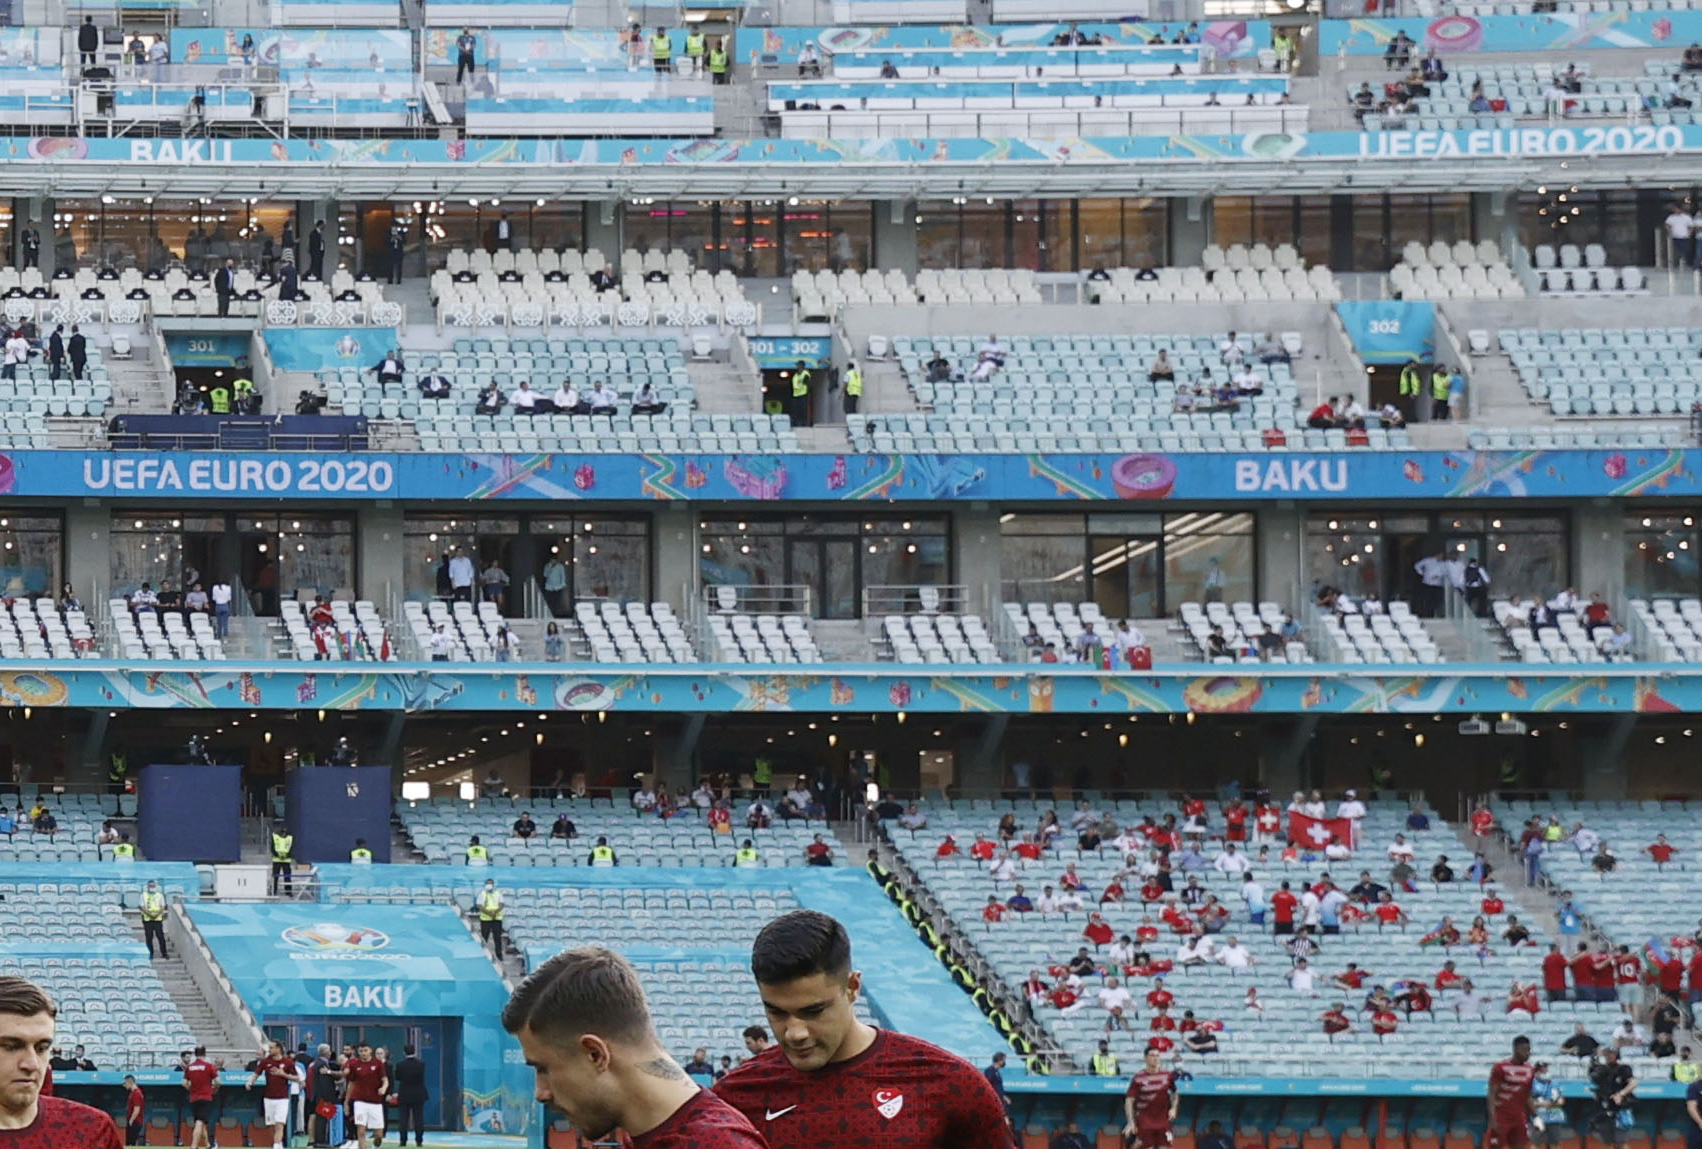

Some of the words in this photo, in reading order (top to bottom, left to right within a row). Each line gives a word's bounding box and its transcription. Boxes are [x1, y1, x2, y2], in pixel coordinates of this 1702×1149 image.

[130, 139, 233, 162] BAKU
[1359, 131, 1460, 157] UEFA
[1467, 128, 1576, 155] EURO
[1582, 125, 1684, 152] 2020
[1370, 319, 1401, 335] 302
[187, 340, 216, 353] 301
[791, 341, 820, 355] 302
[83, 458, 183, 490] UEFA
[188, 459, 292, 491] EURO
[297, 459, 394, 492] 2020
[1235, 459, 1348, 492] BAKU
[1619, 963, 1636, 977] 10
[324, 984, 404, 1010] BAKU
